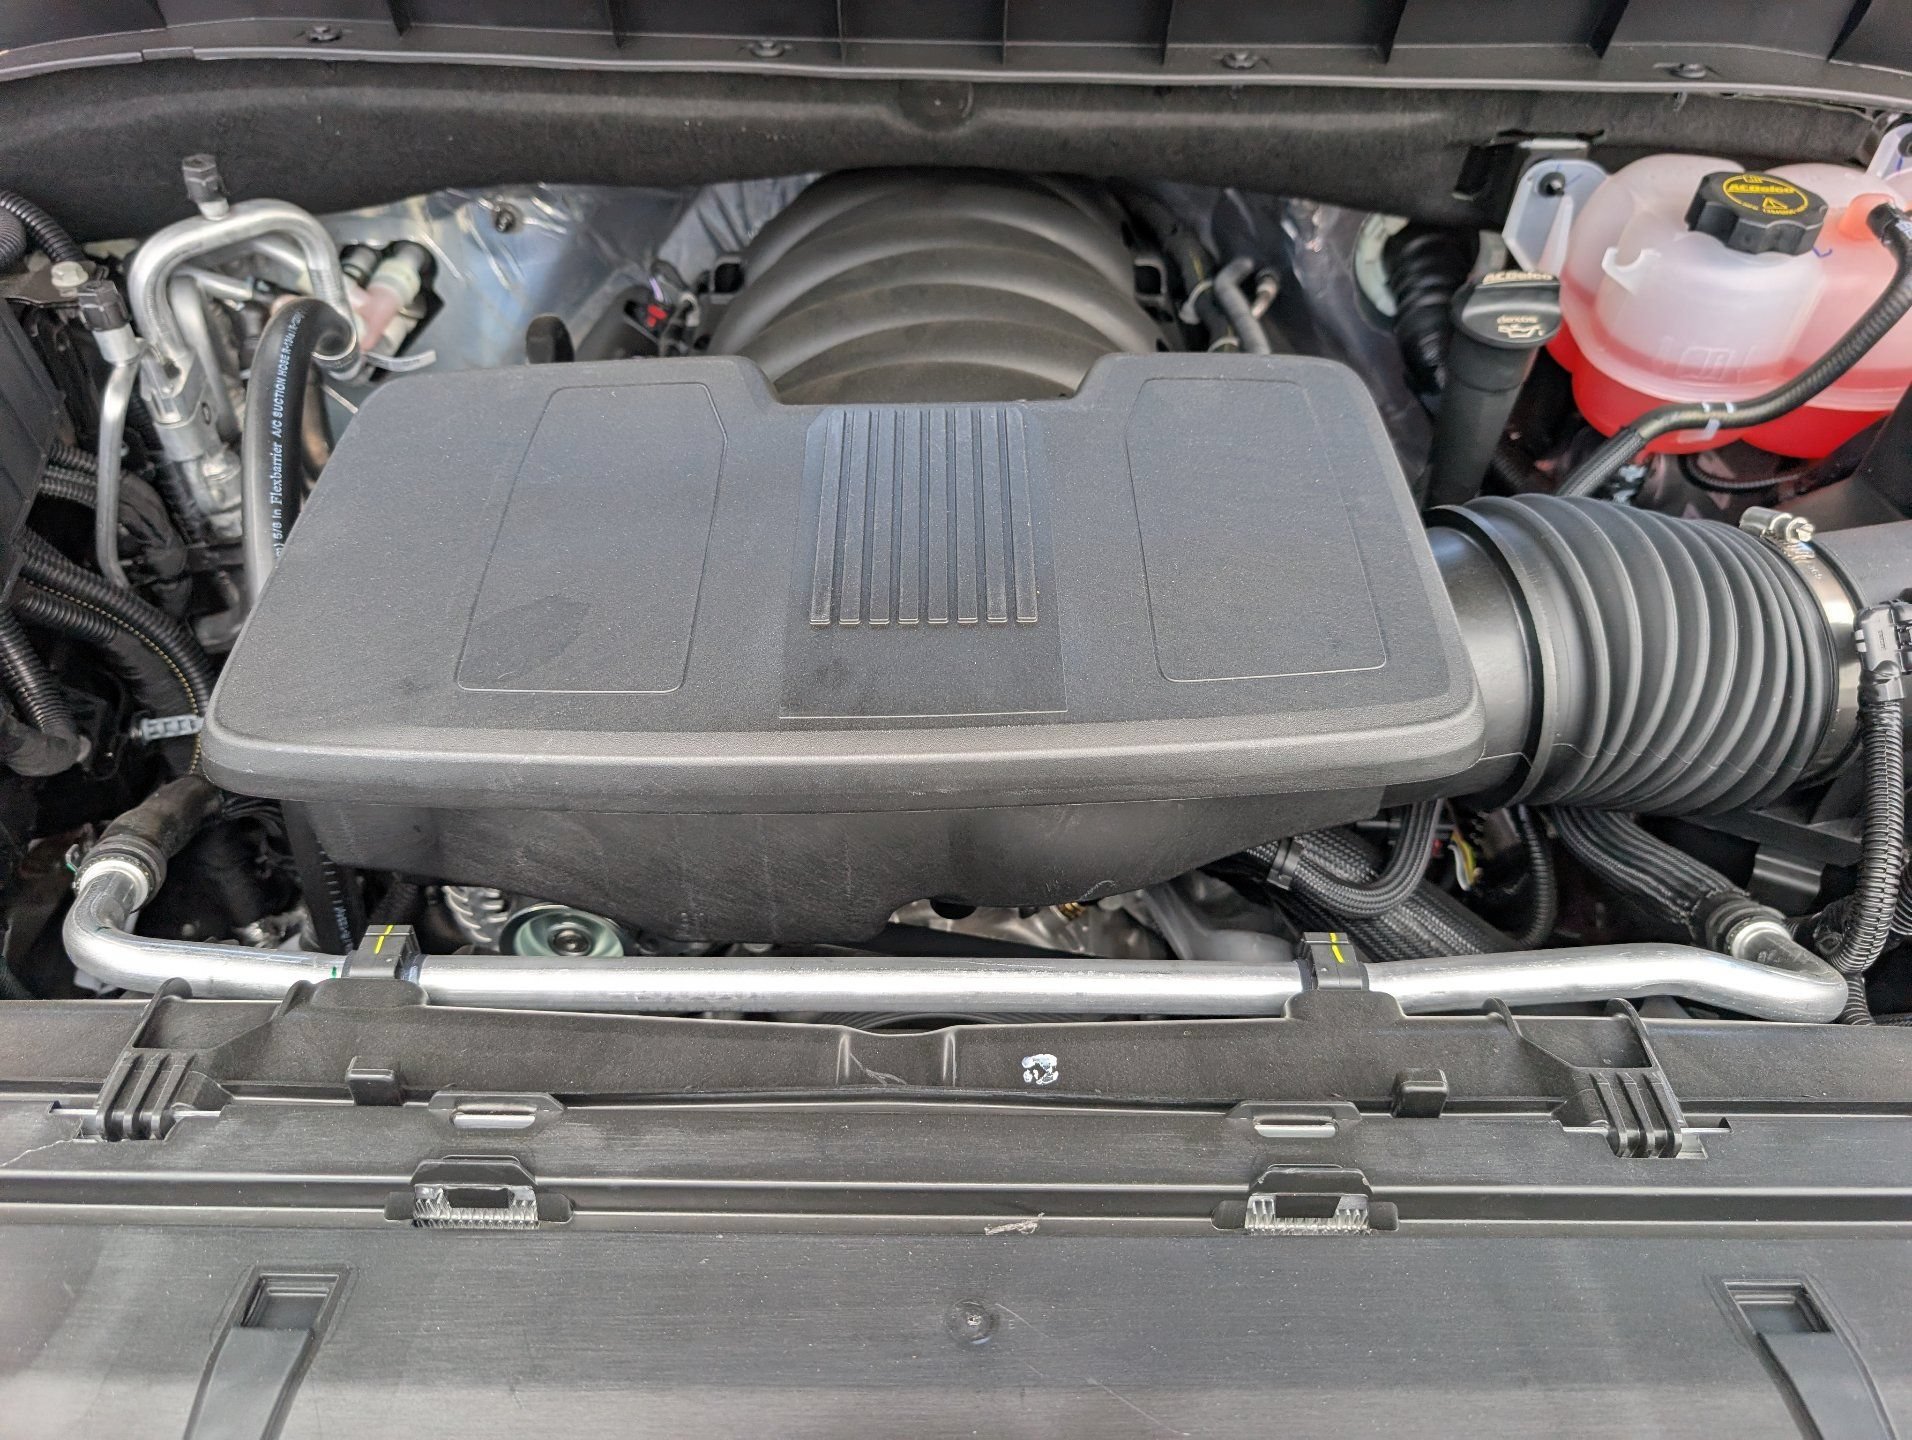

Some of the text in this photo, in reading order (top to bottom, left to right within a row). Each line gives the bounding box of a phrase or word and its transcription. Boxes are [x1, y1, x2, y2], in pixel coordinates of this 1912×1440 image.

[272, 378, 287, 418] SUCTION
[270, 420, 283, 438] A/C
[270, 441, 283, 506] Flexbarrier
[272, 521, 283, 540] 5/8
